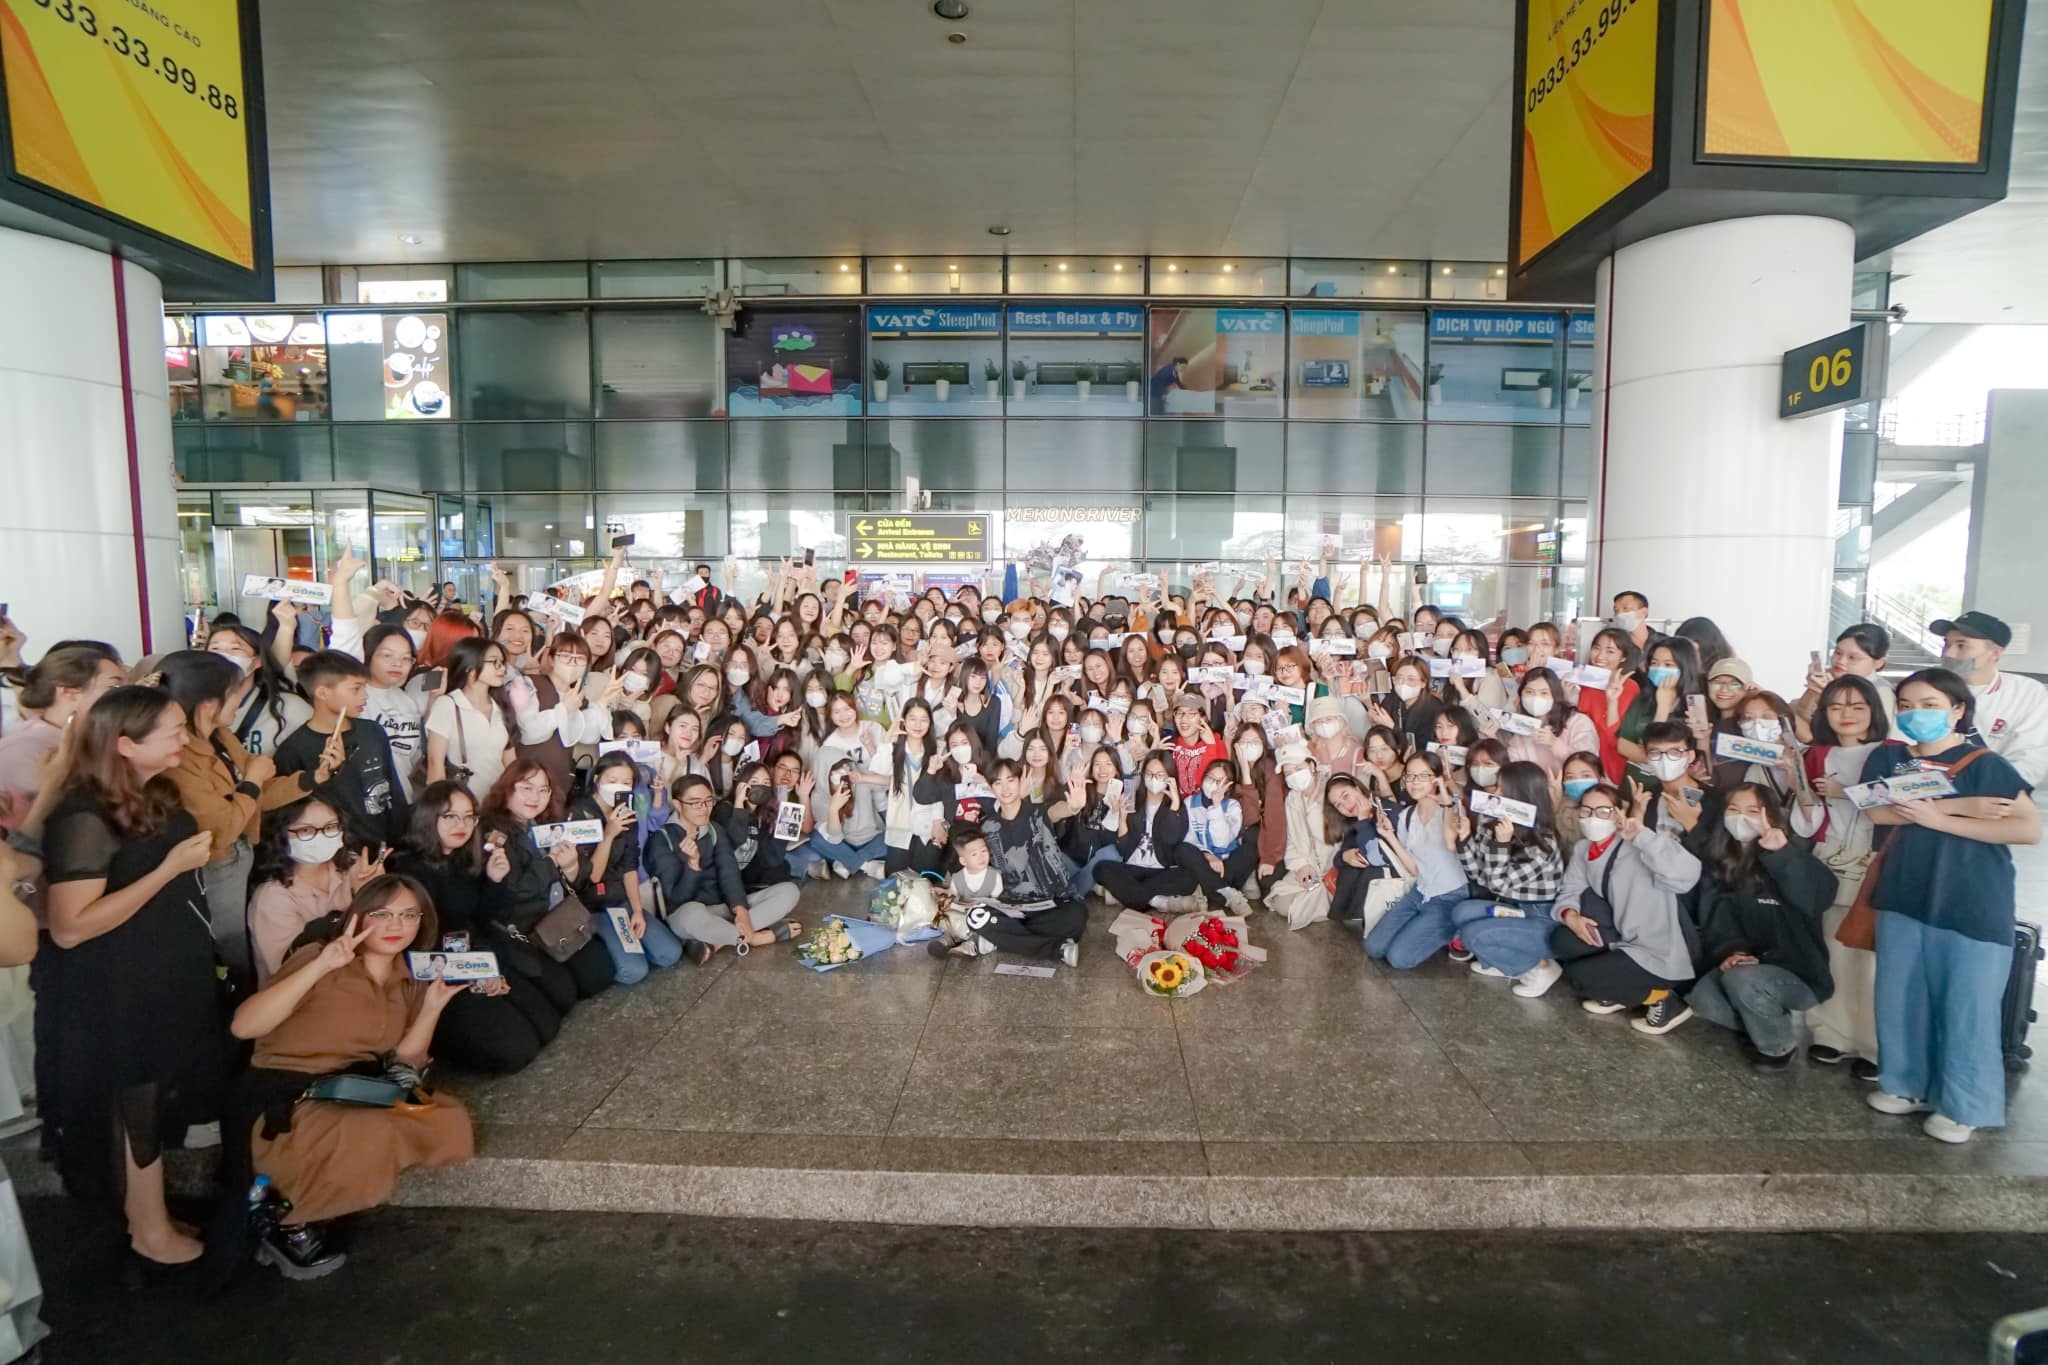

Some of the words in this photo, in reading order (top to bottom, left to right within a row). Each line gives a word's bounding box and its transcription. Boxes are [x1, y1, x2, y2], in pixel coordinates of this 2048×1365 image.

[35, 0, 238, 119] 33.33.99.88
[1528, 0, 1637, 113] 0933.33.99.
[874, 314, 932, 327] VATC
[939, 312, 996, 329] SleepPod
[1015, 311, 1051, 326] Rest,
[1056, 311, 1096, 325] Relax
[1100, 311, 1111, 325] &
[1116, 311, 1138, 328] Fly
[1222, 318, 1273, 331] VATC
[1437, 317, 1469, 333] DỊCH
[1473, 318, 1491, 335] VỤ
[1495, 317, 1523, 335] HỘP
[1809, 348, 1852, 393] 06
[1787, 392, 1802, 407] 1F
